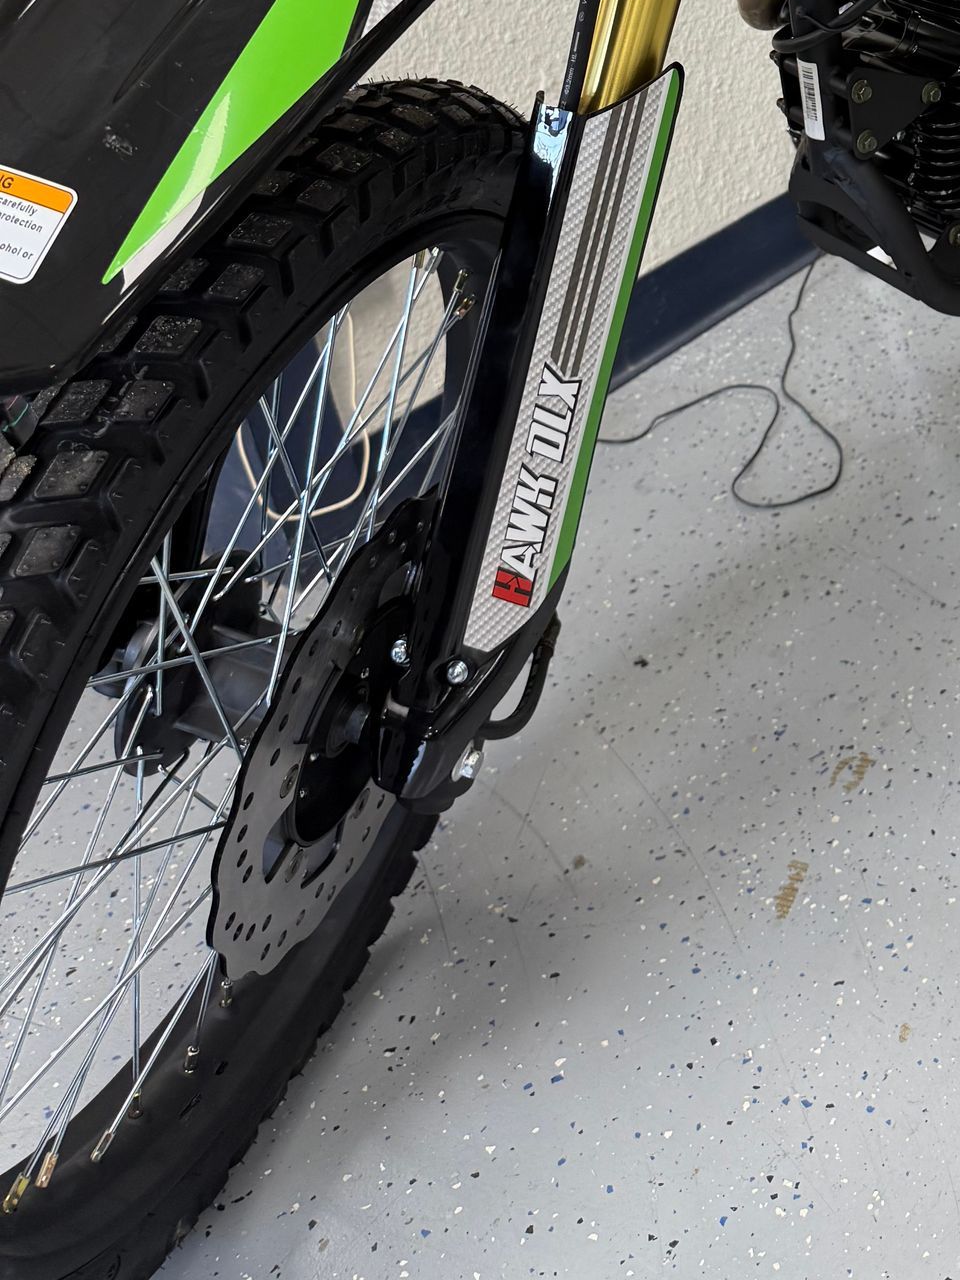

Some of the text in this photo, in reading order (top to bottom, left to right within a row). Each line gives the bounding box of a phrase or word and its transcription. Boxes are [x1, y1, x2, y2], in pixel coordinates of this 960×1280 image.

[22, 251, 34, 260] or
[491, 361, 582, 608] HAWK DLX
